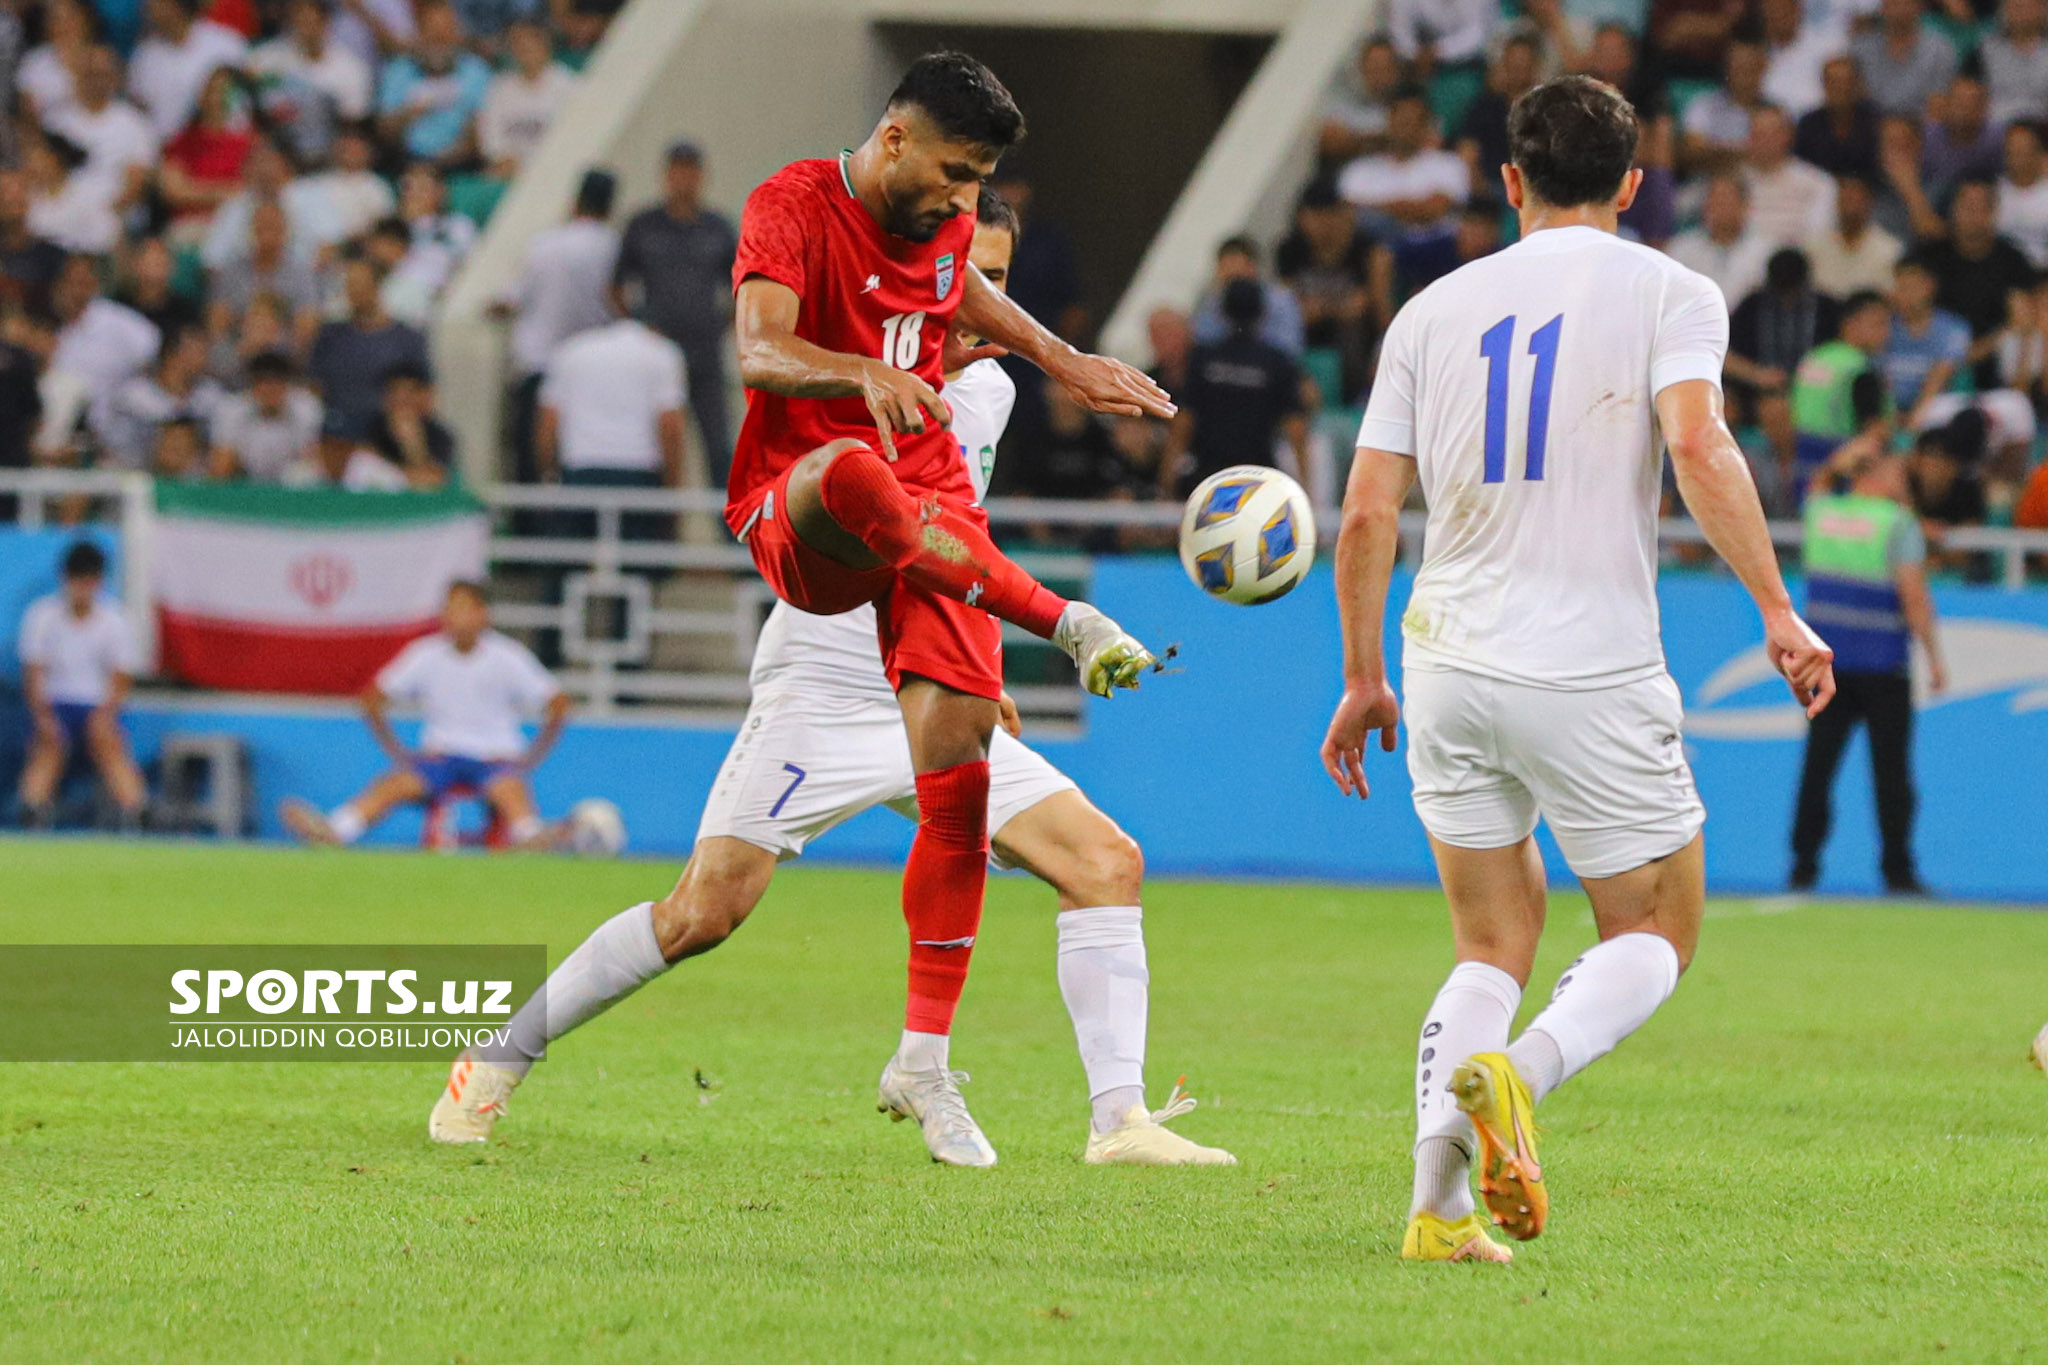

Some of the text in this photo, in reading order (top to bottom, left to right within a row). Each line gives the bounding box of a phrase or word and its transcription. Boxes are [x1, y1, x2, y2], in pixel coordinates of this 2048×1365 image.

[882, 311, 926, 370] 18
[1480, 312, 1565, 484] 11
[769, 763, 805, 817] 7
